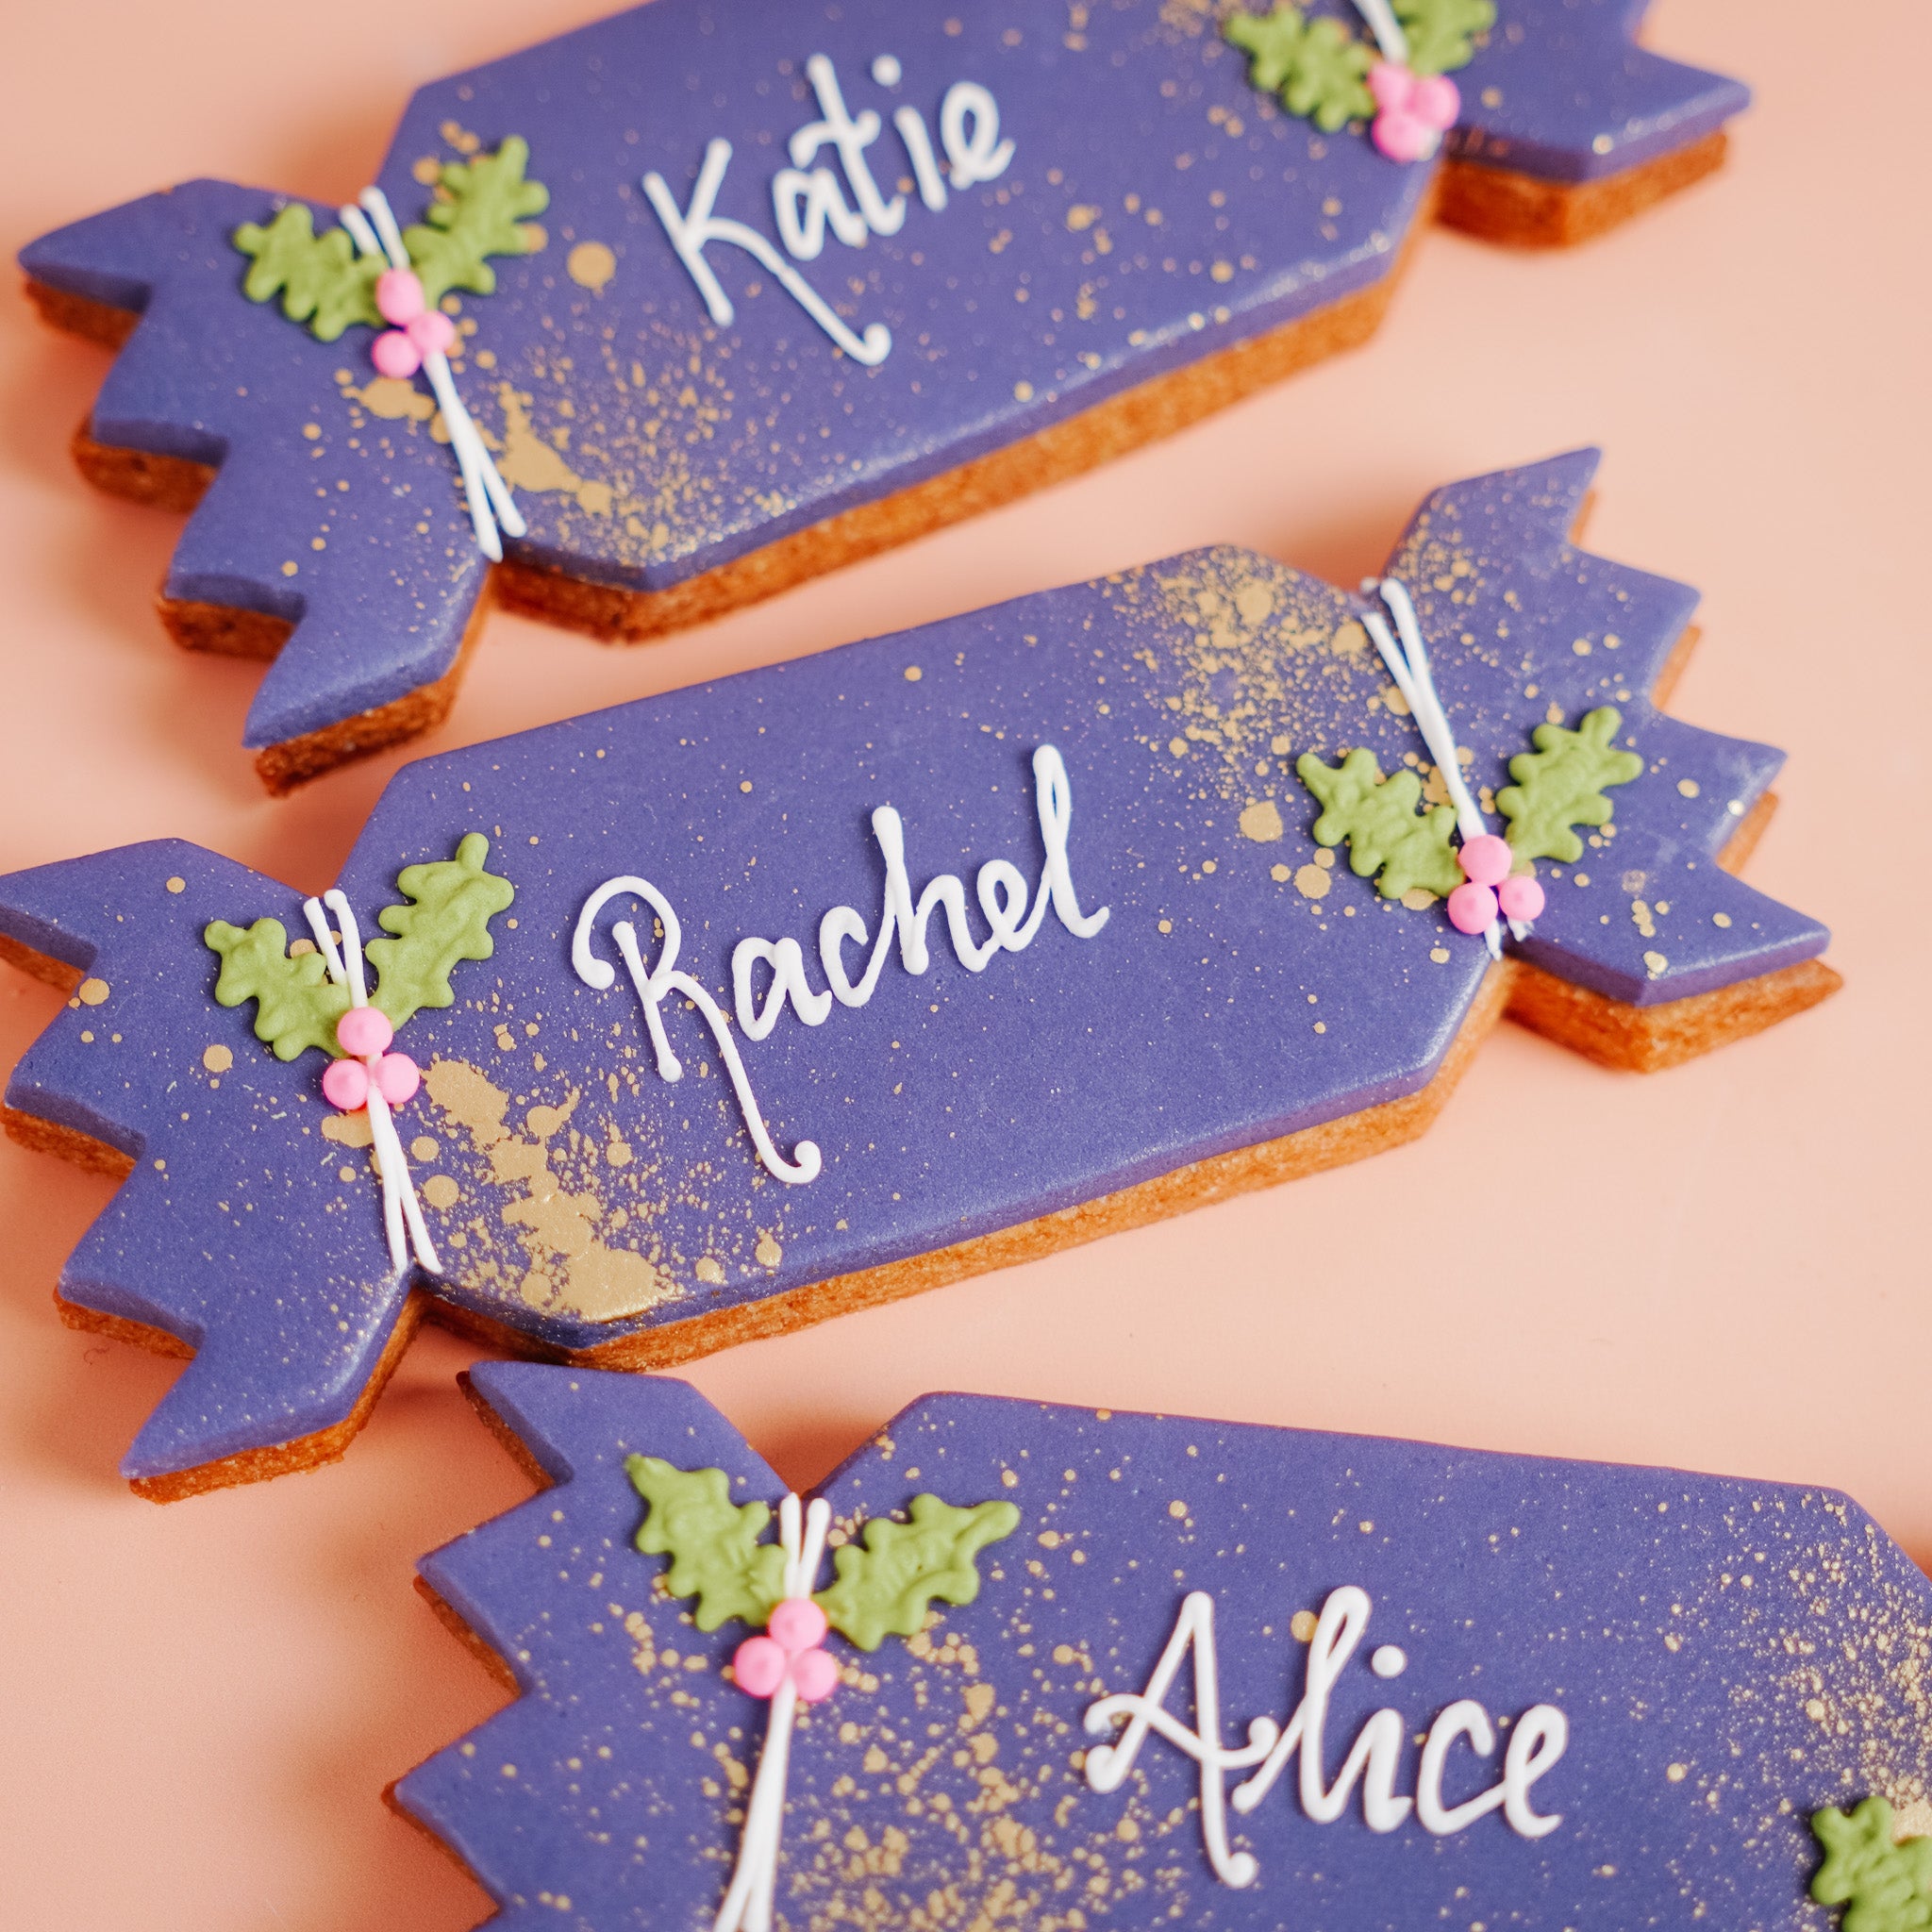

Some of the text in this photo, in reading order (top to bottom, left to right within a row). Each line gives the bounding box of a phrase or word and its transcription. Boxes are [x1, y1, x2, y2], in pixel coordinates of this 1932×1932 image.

[643, 54, 1015, 366] Katie
[570, 743, 1111, 1185] Rachel
[1084, 1585, 1568, 1888] Alice
